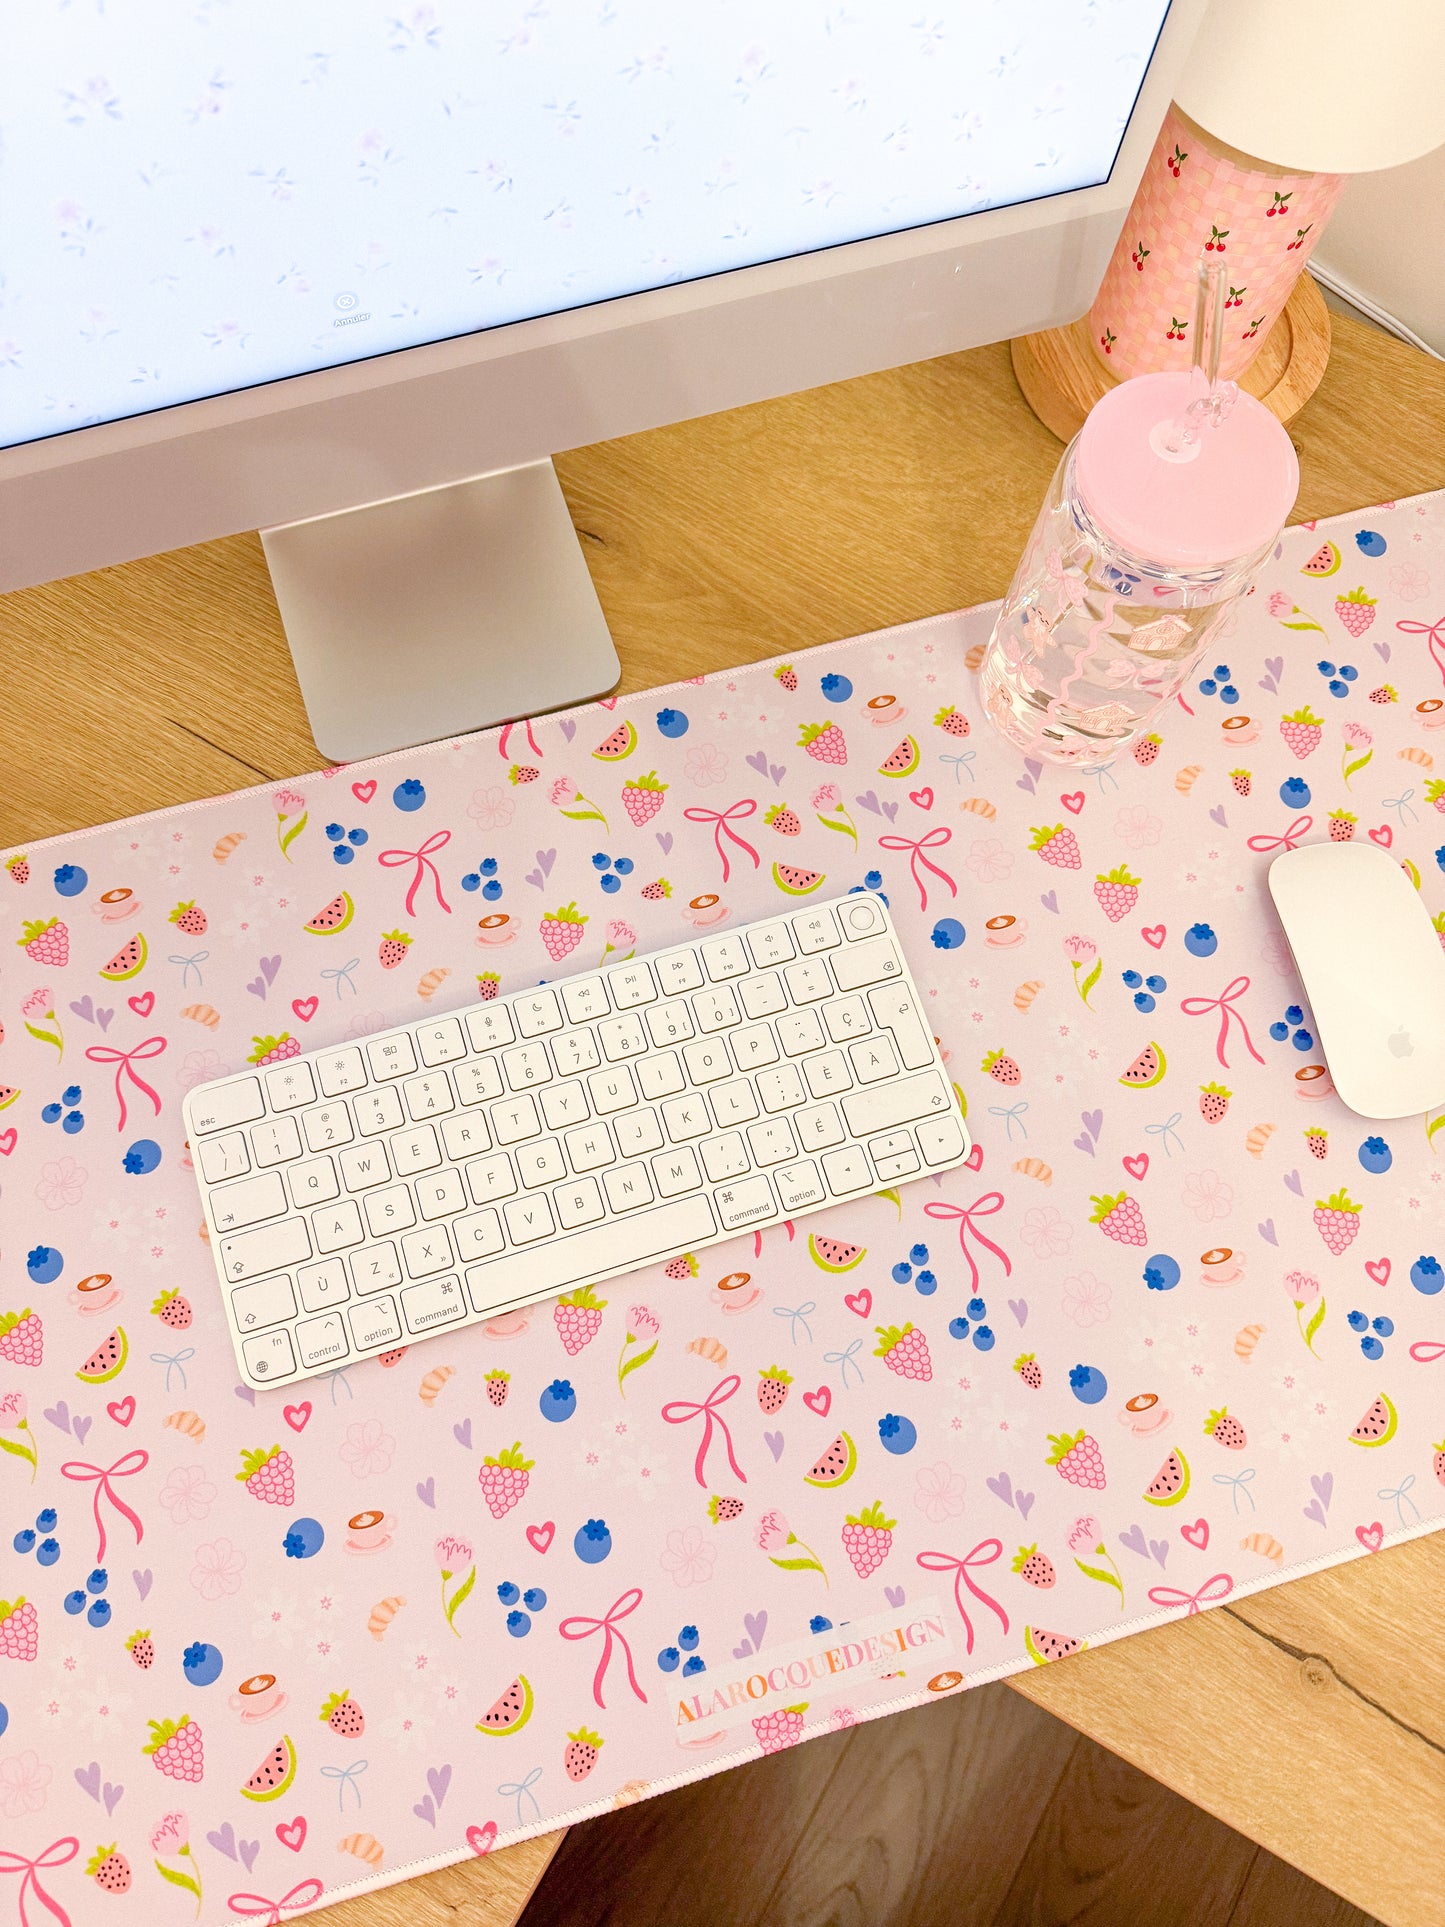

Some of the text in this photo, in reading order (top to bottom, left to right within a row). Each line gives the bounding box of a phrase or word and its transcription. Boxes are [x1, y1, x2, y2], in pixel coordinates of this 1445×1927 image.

[334, 313, 371, 328] Annuler
[714, 1010, 724, 1022] 0
[842, 1012, 852, 1027] Ç
[667, 1024, 677, 1036] 9
[620, 1038, 630, 1050] 8
[749, 1040, 758, 1053] P
[572, 1052, 580, 1065] 7
[702, 1055, 713, 1067] O
[868, 1051, 880, 1066] À
[525, 1067, 534, 1079] 6
[822, 1065, 833, 1080] È
[476, 1082, 486, 1094] 5
[607, 1083, 618, 1096] U
[427, 1097, 436, 1109] 4
[559, 1098, 568, 1110] Y
[729, 1098, 739, 1109] L
[200, 1117, 215, 1126] esc
[375, 1112, 385, 1125] 3
[510, 1113, 519, 1125] T
[681, 1111, 692, 1124] K
[815, 1117, 825, 1133] É
[325, 1127, 335, 1140] 2
[460, 1129, 472, 1142] R
[635, 1126, 643, 1139] J
[274, 1143, 281, 1155] 1
[411, 1144, 421, 1157] E
[584, 1140, 596, 1154] H
[357, 1159, 371, 1173] W
[536, 1156, 546, 1169] G
[487, 1171, 495, 1185] F
[670, 1165, 683, 1179] M
[307, 1175, 319, 1189] Q
[622, 1180, 634, 1194] N
[435, 1188, 446, 1201] D
[789, 1189, 816, 1204] option
[574, 1196, 585, 1210] B
[384, 1204, 395, 1217] S
[729, 1203, 770, 1223] command
[523, 1211, 533, 1225] V
[334, 1221, 344, 1234] A
[473, 1228, 484, 1242] C
[421, 1244, 433, 1259] X
[370, 1261, 381, 1275] Z
[317, 1276, 329, 1292] Ù
[414, 1304, 459, 1326] command
[364, 1326, 393, 1343] option
[271, 1337, 282, 1346] fn
[309, 1343, 341, 1360] control
[676, 1615, 946, 1726] ALAROCQUEDESIGN
